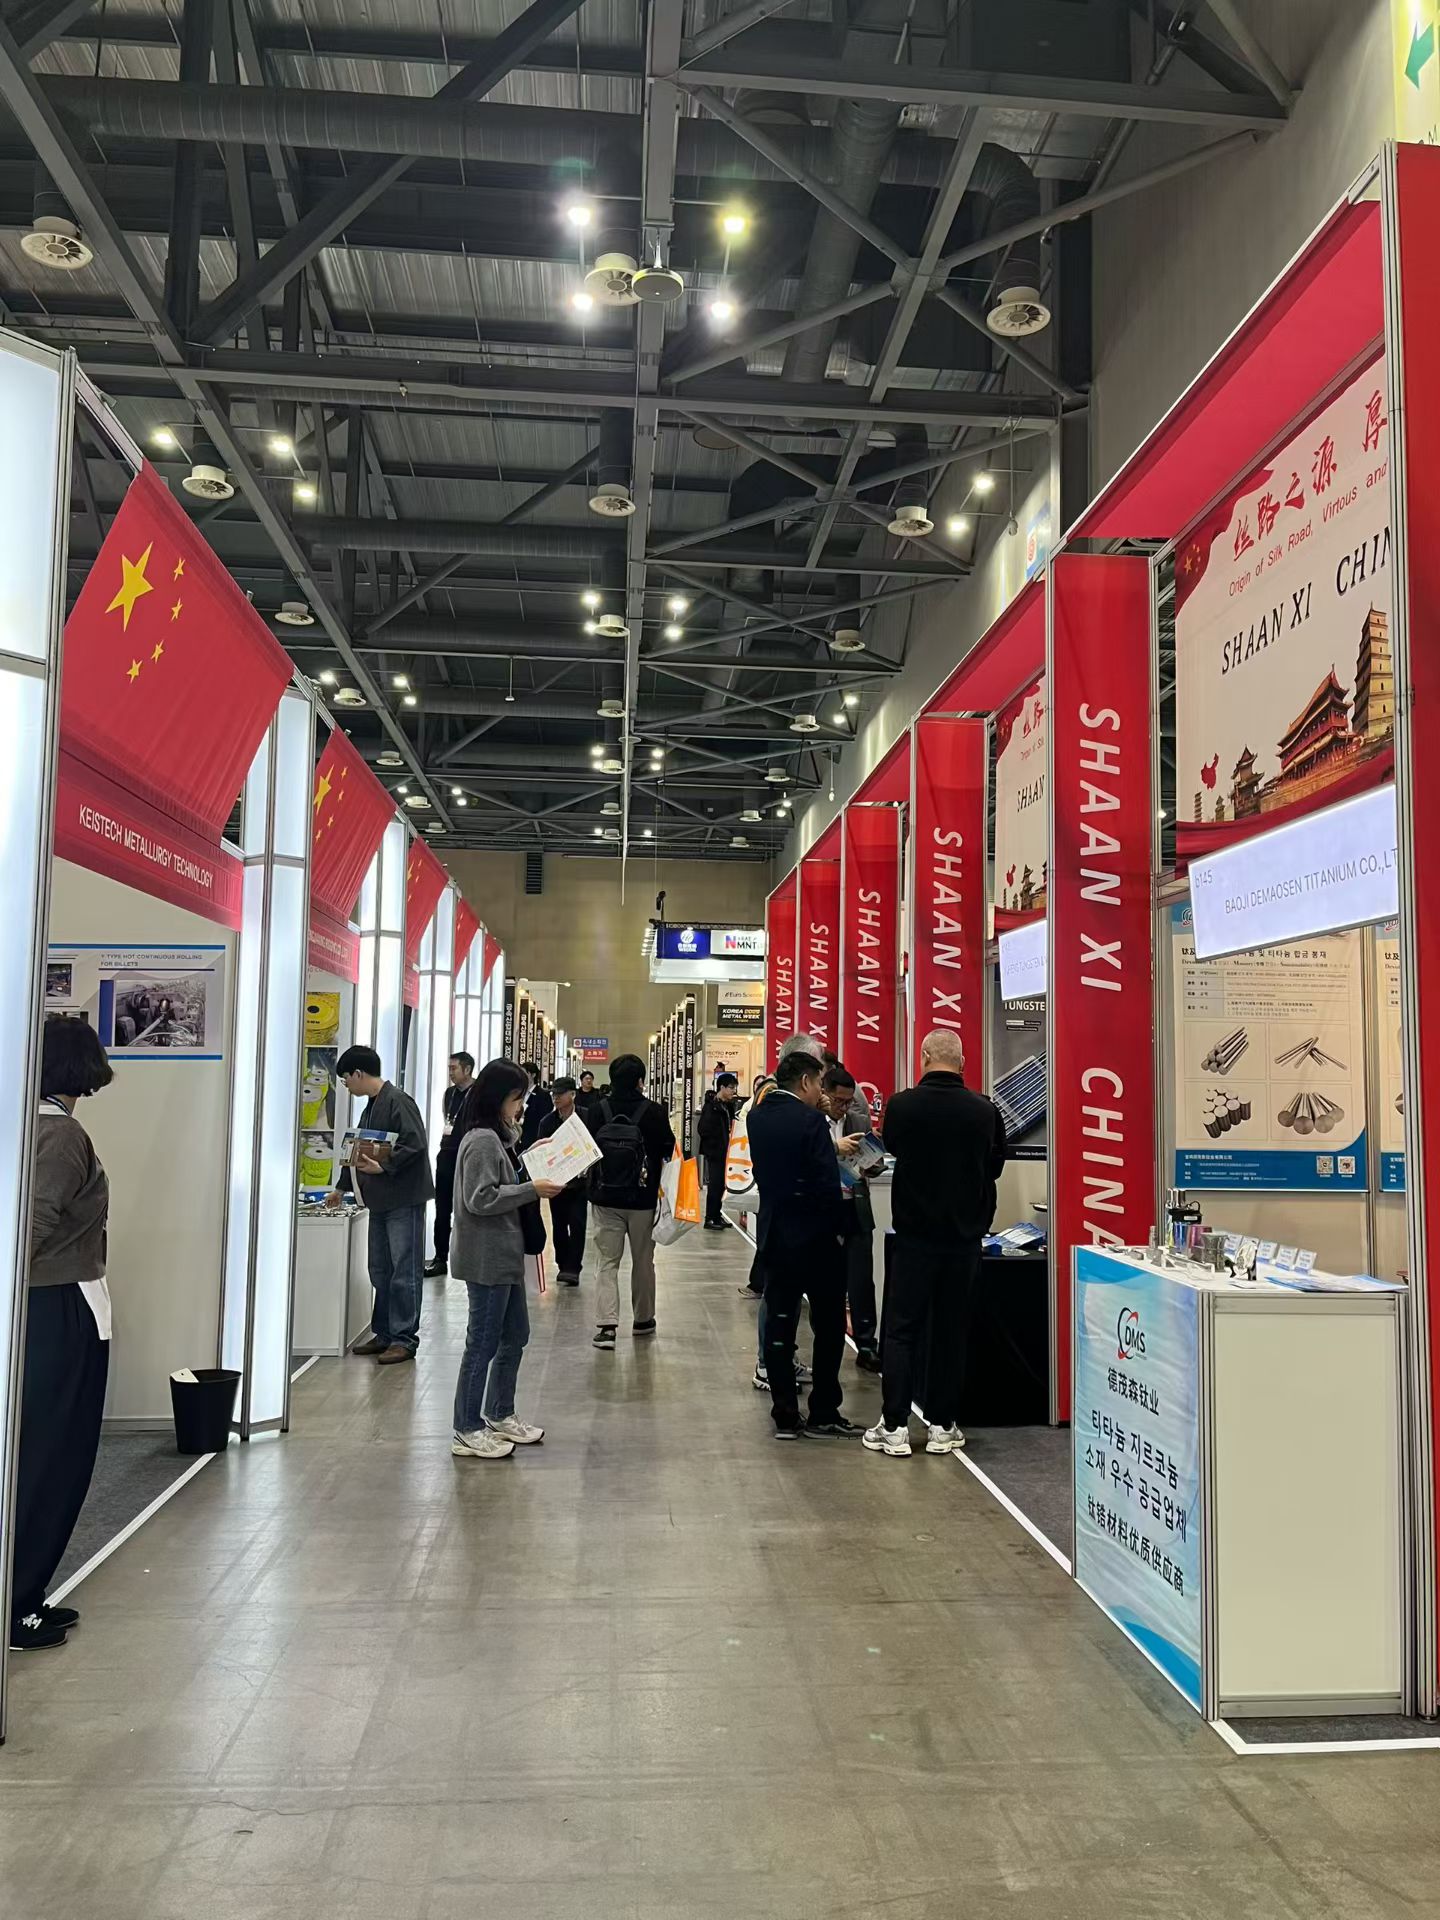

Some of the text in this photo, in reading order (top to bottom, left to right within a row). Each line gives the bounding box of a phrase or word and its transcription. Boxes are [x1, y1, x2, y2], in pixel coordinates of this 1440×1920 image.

[1233, 389, 1387, 561] 丝路之源 厚
[1229, 457, 1388, 597] Origin of Silk Road, Virtous and
[1221, 603, 1285, 675] SHAAN
[1291, 581, 1312, 629] XI
[80, 804, 213, 889] KEISTECH METALLURGY TECHNOLOGY
[1195, 869, 1213, 888] b145
[1225, 896, 1250, 914] BAOJI
[1251, 879, 1303, 907] DEMAOSEN
[1304, 860, 1357, 891] TITANIUM
[809, 922, 829, 1011] SHAAN
[856, 888, 881, 1043] SHAAN XI
[932, 827, 963, 1029] SHAAN XI
[776, 955, 792, 1030] SHAAN
[1079, 703, 1125, 1247] SHAAN XI CHINA
[1125, 1325, 1146, 1354] DMS
[1108, 1366, 1159, 1416] 德茂森钛业
[1085, 1443, 1187, 1543] 소재 우수 공급업체
[1092, 1409, 1179, 1491] 티타늄 지르코늄
[1087, 1493, 1185, 1597] 钛锆材料优质供应商
